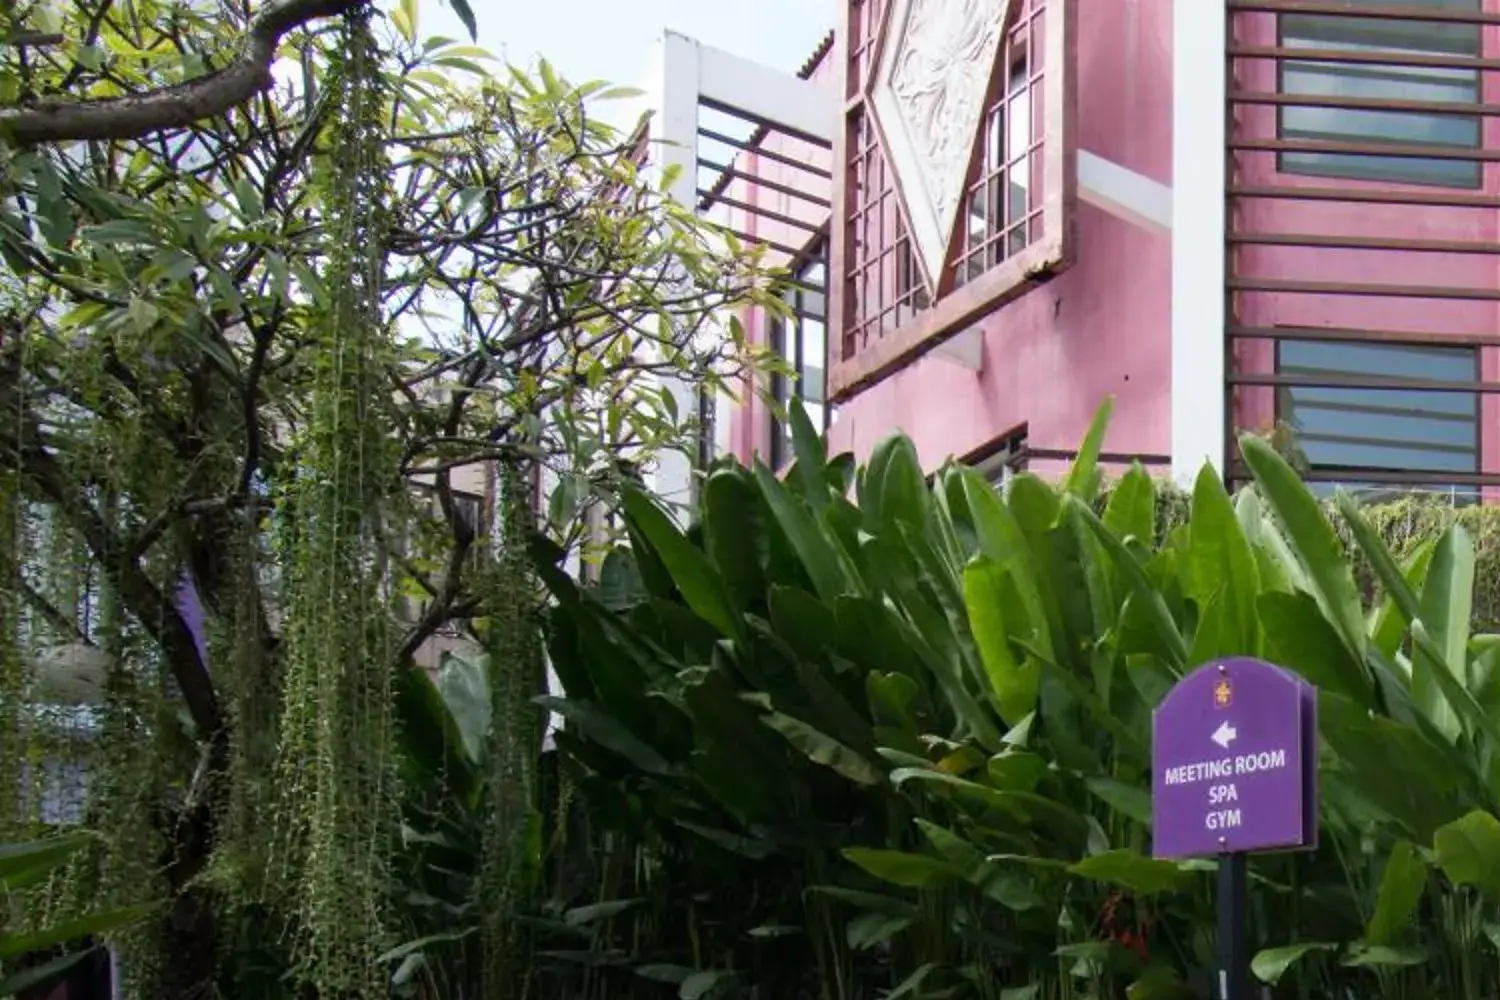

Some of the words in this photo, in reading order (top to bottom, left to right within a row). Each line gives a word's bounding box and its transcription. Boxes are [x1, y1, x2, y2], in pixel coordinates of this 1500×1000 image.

[1165, 758, 1232, 785] MEETING
[1235, 749, 1285, 775] ROOM
[1208, 784, 1238, 804] SPA
[1205, 809, 1241, 830] GYM
